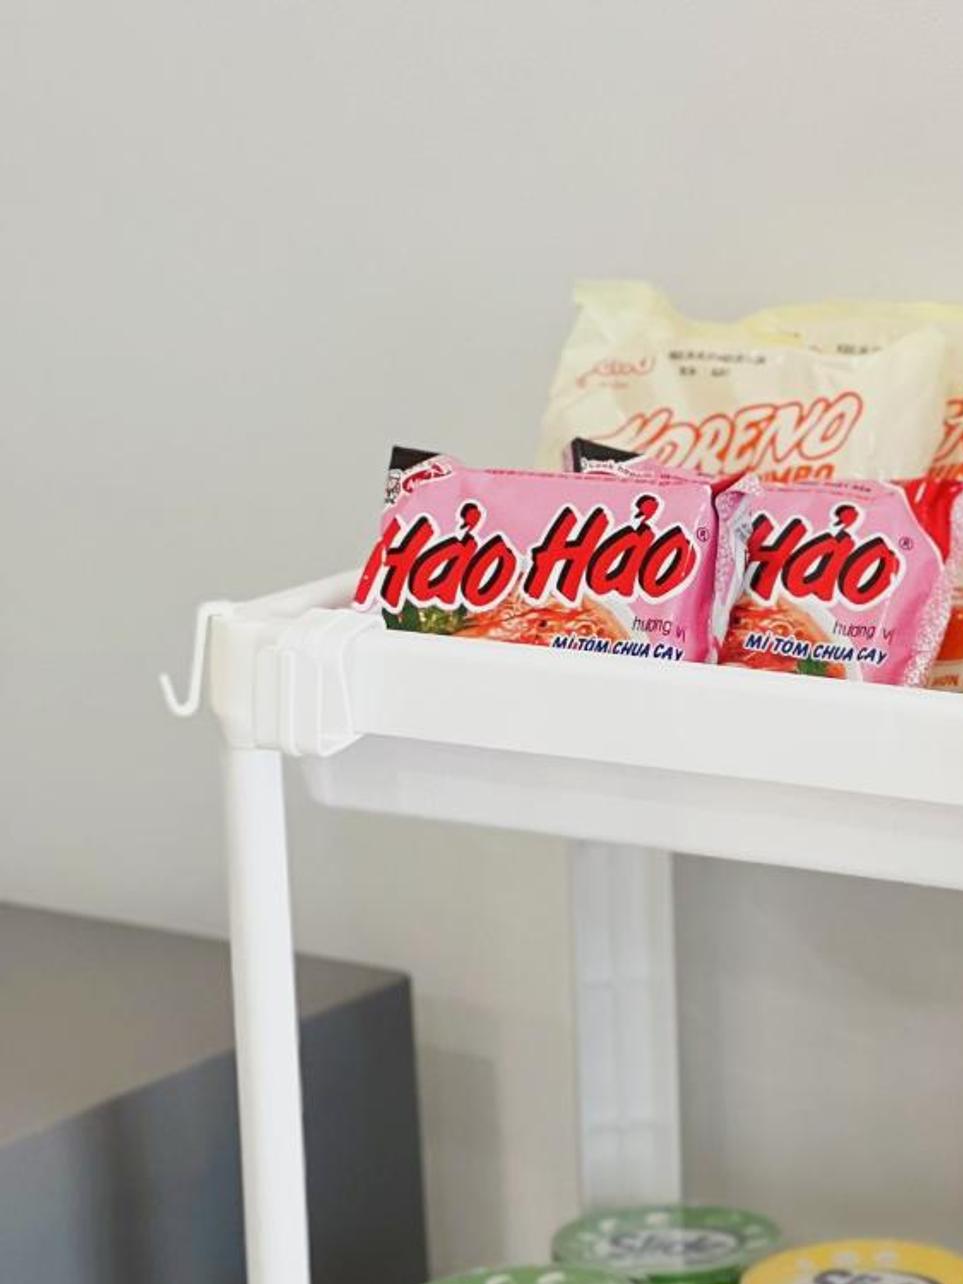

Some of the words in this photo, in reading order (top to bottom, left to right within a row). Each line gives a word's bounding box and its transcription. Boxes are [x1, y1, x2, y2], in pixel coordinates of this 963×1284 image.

[354, 502, 517, 607] Hảo
[523, 494, 700, 602] Hảo
[746, 504, 900, 603] Hảo
[612, 641, 650, 658] CHUA
[653, 644, 683, 661] CAY
[813, 644, 855, 660] CHUA
[857, 647, 888, 664] CAY
